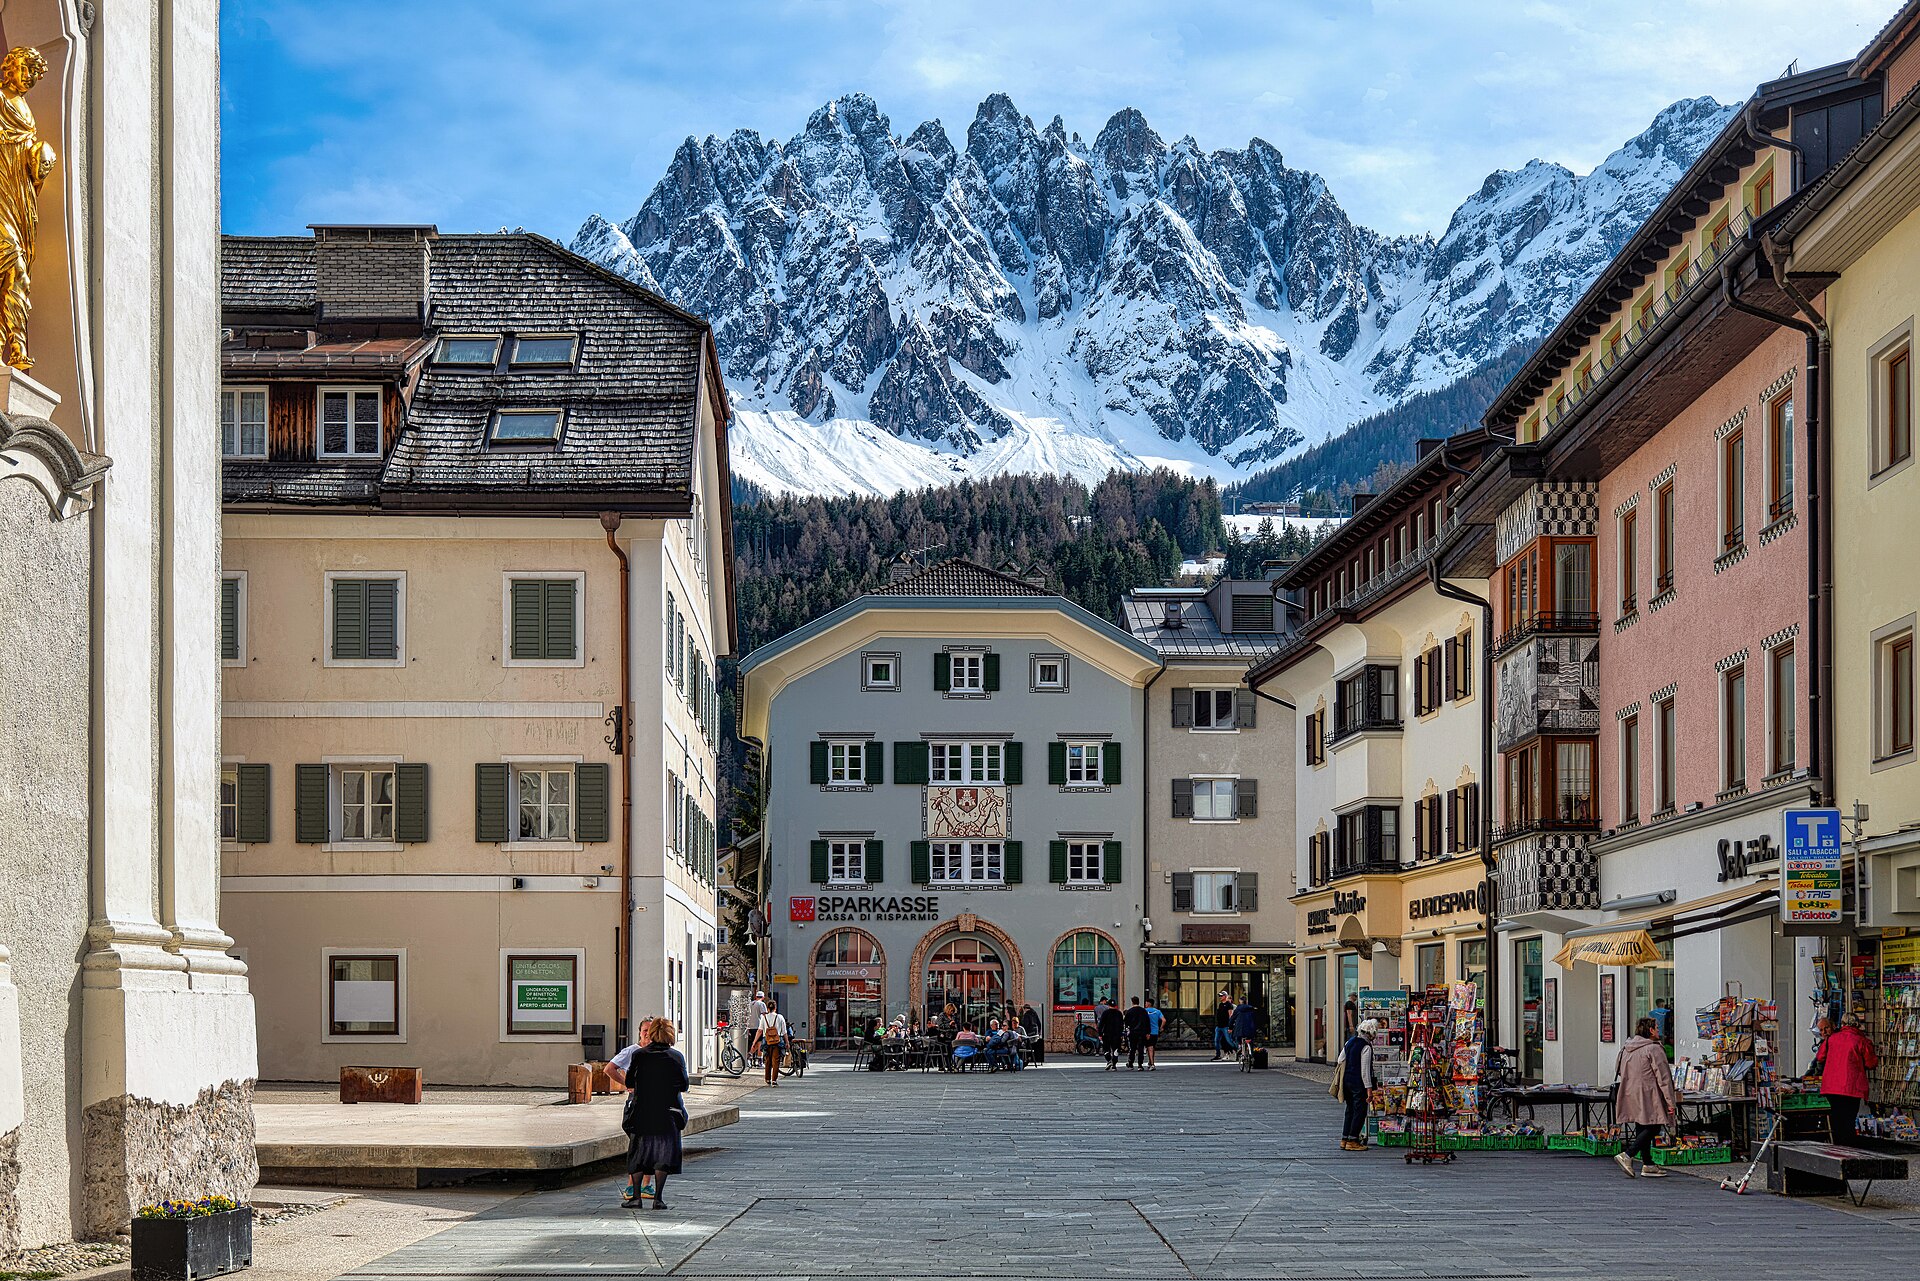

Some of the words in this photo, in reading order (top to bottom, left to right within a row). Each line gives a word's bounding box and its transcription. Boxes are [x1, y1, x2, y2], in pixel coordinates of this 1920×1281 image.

[1797, 817, 1828, 847] T
[1717, 834, 1780, 883] Schäfe
[1787, 848, 1802, 856] SALI
[1788, 861, 1823, 870] LOTTO
[817, 896, 939, 913] SPARKASSE
[1409, 889, 1477, 920] EUROSPAR
[817, 913, 855, 921] CASSA
[859, 913, 871, 921] DI
[876, 913, 939, 921] RISPARMIO
[1792, 911, 1831, 919] Enalotto
[1616, 942, 1642, 955] LOTTO
[1172, 954, 1257, 967] JUWELIER
[374, 1073, 382, 1081] H
